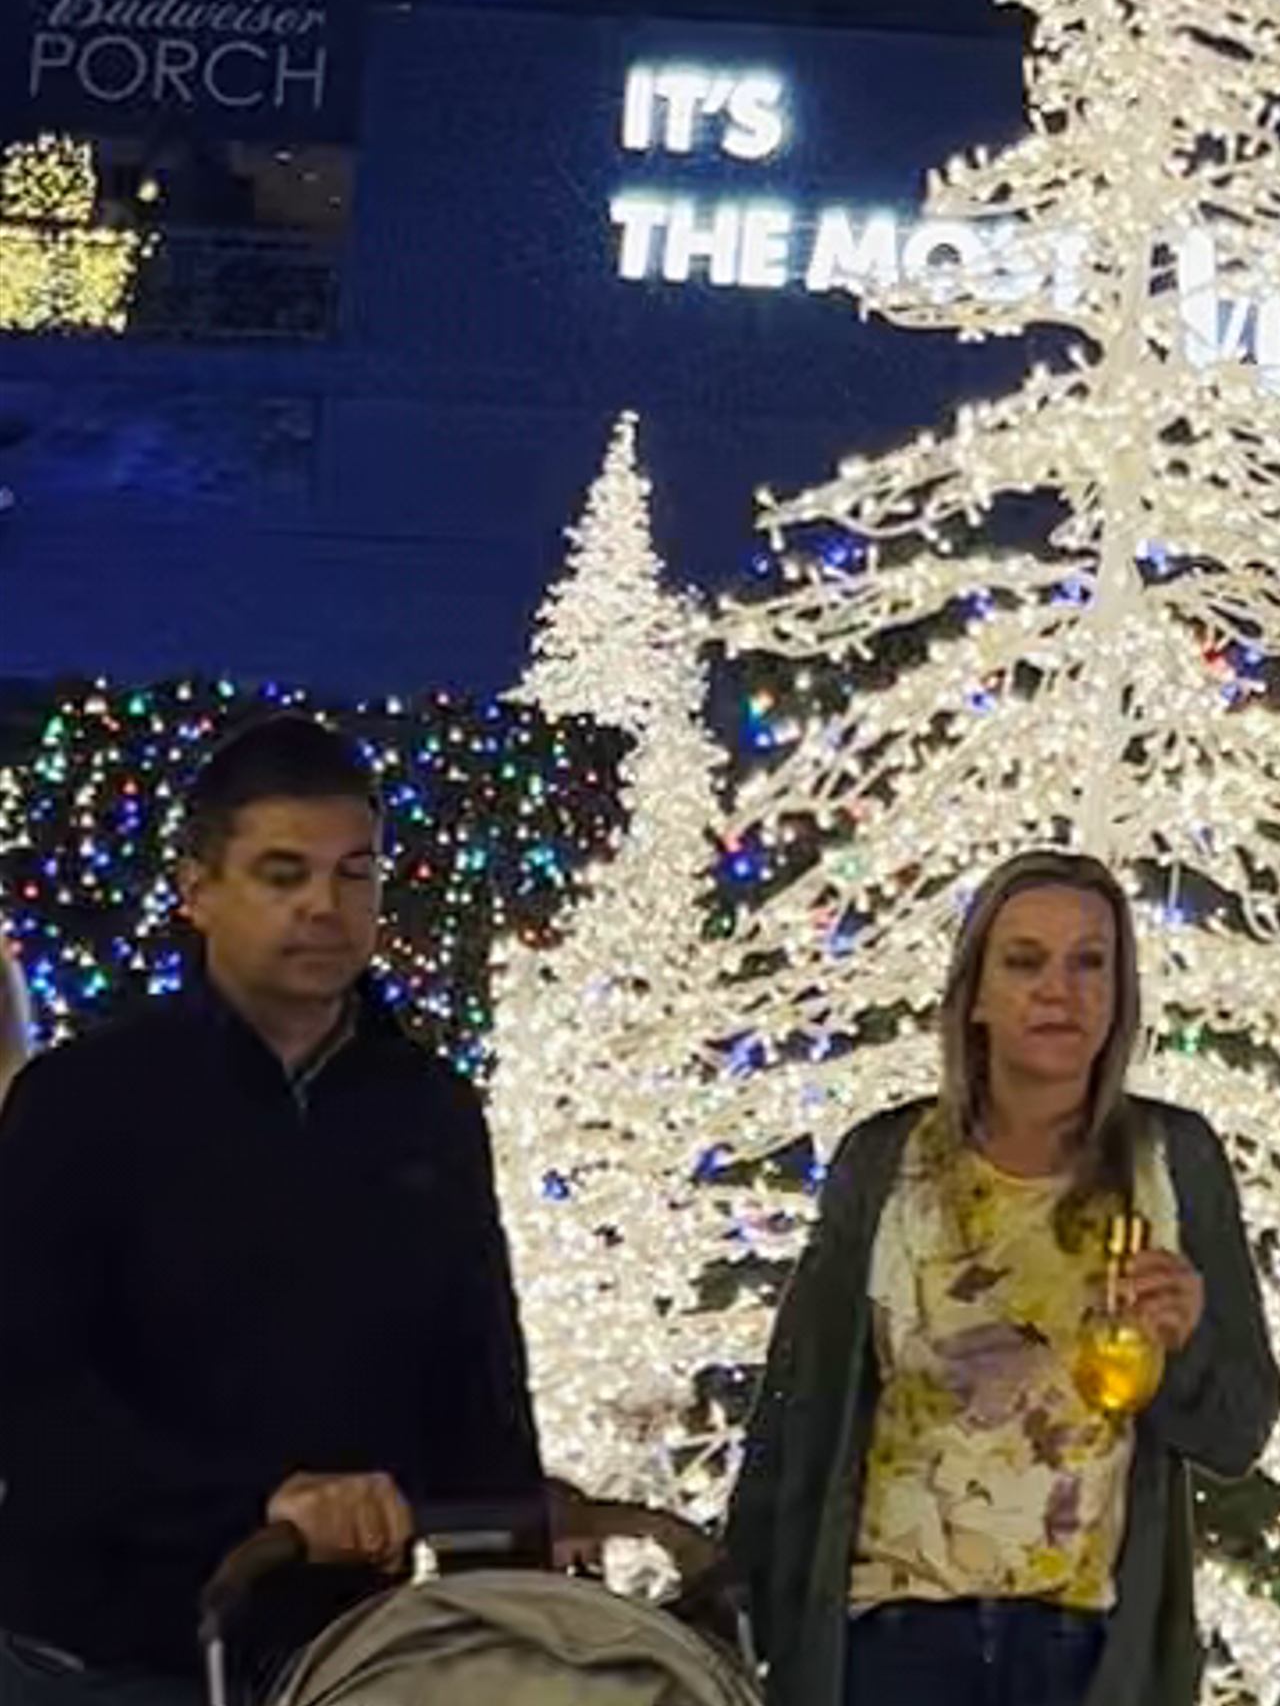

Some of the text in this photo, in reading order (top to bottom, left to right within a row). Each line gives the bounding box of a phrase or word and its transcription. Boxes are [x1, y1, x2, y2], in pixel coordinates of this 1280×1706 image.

[28, 32, 328, 109] PORCH
[618, 66, 785, 161] IT'S
[608, 194, 790, 288] THE
[805, 208, 1092, 312] MOST
